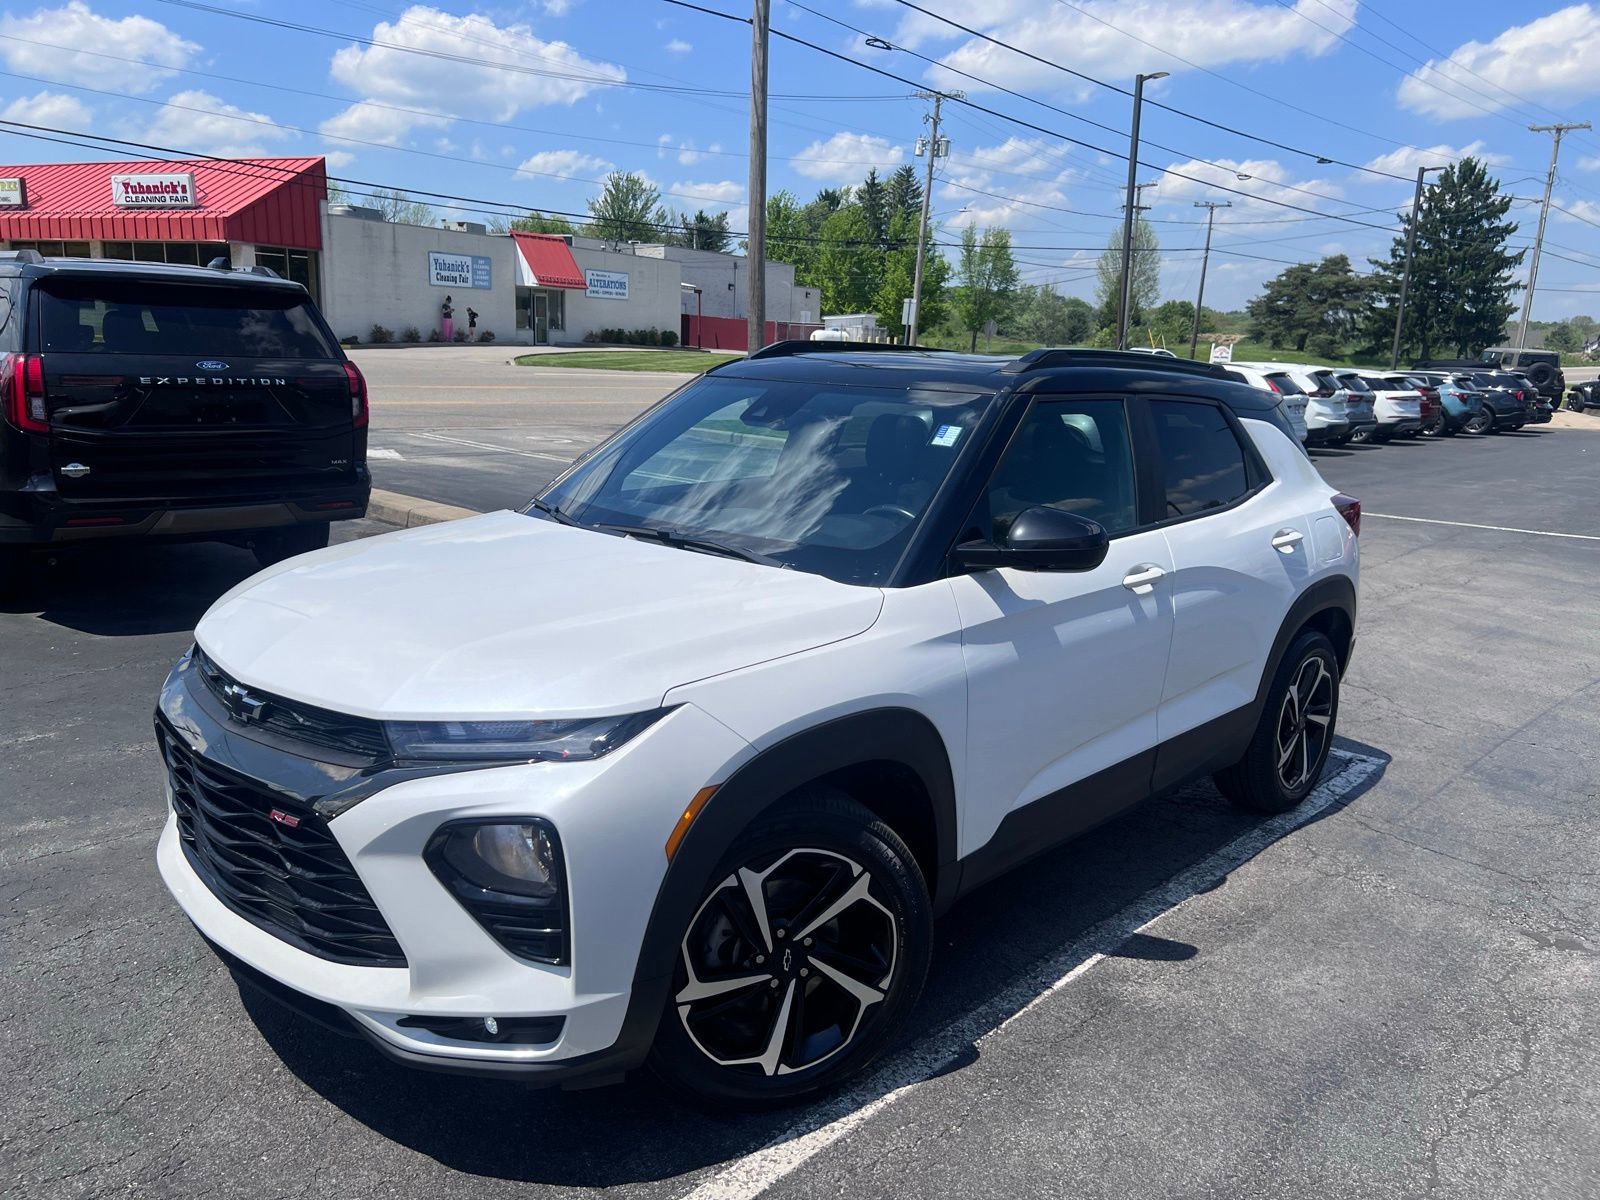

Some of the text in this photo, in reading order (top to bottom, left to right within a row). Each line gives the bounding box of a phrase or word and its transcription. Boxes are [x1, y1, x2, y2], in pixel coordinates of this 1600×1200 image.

[122, 181, 187, 195] Yuhanick's
[433, 258, 470, 274] Yuhanick's
[436, 272, 458, 284] Cleaning
[459, 273, 469, 284] Fair
[589, 278, 627, 290] ALTERATIONS
[140, 376, 286, 386] EXPEDITION
[271, 809, 300, 828] RS
